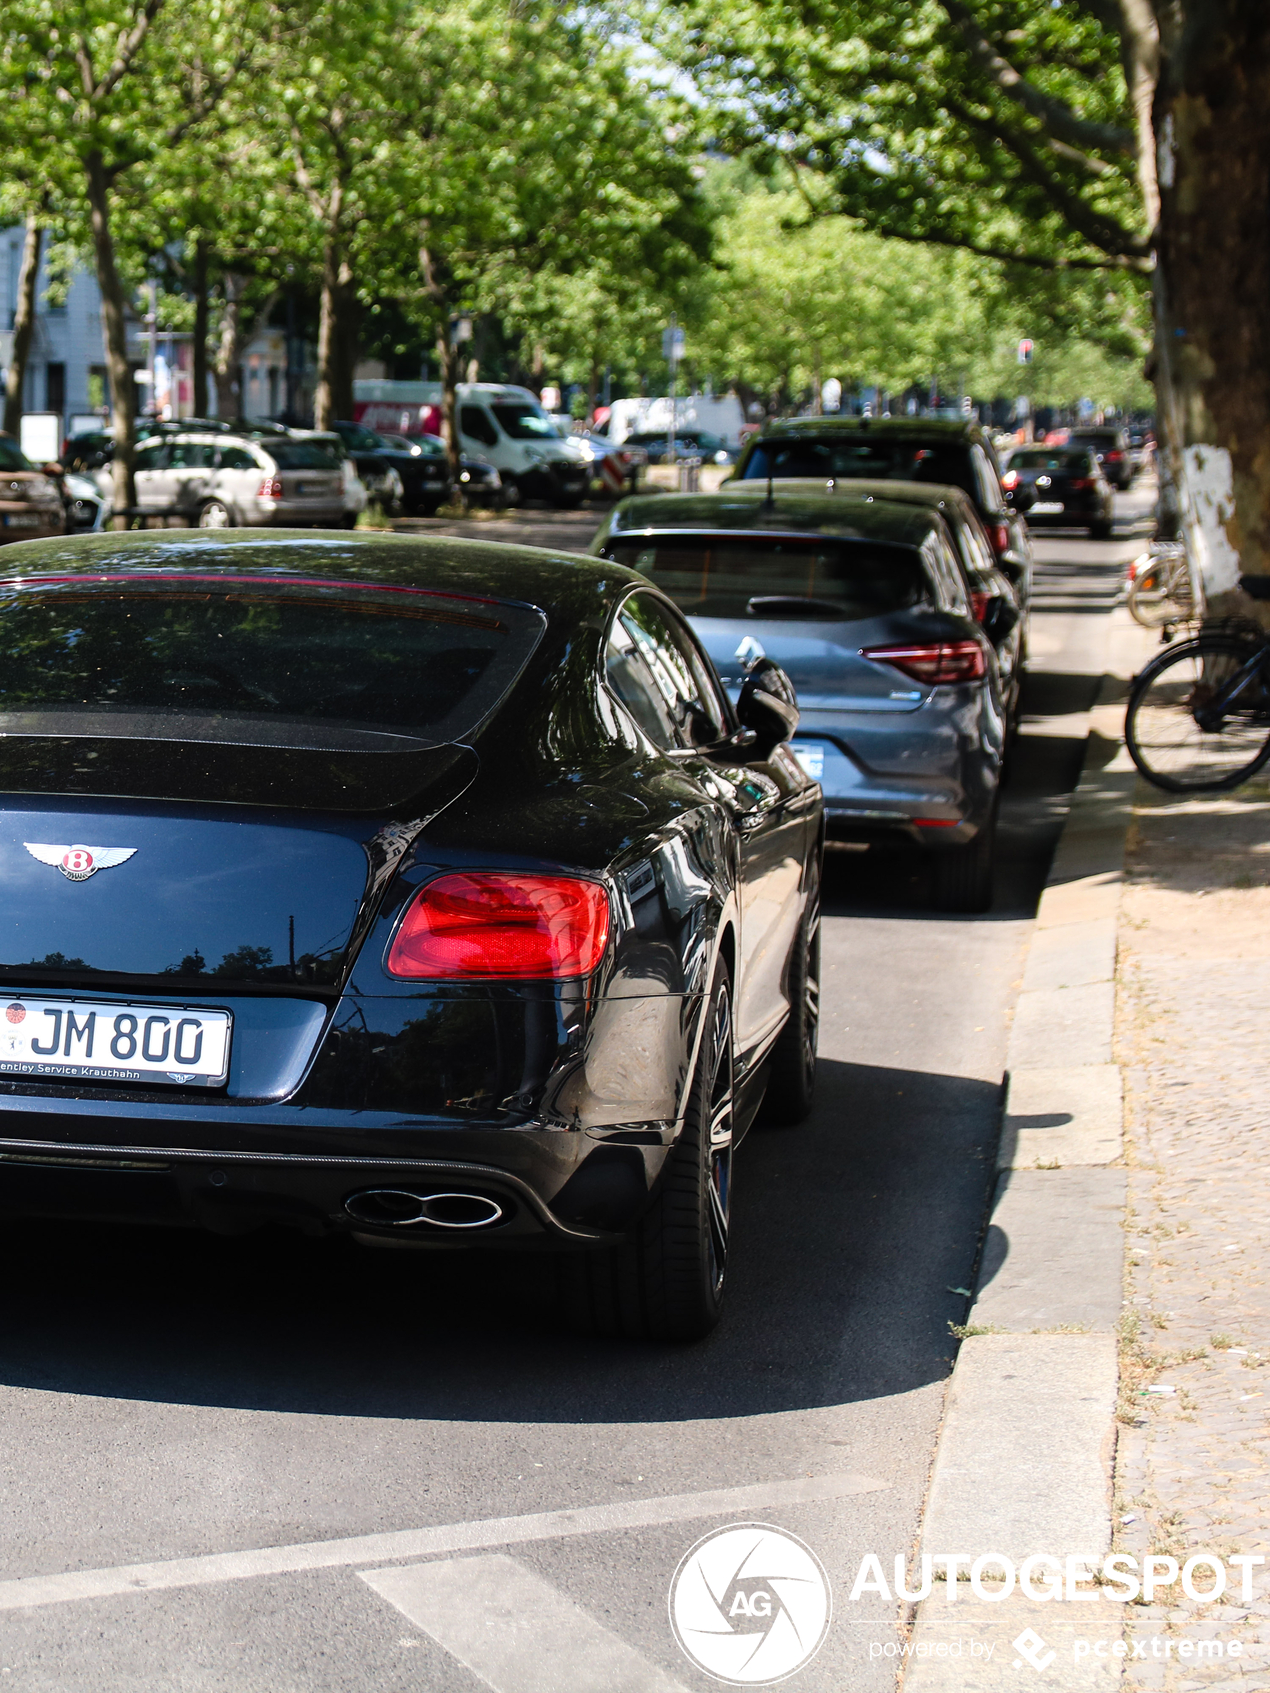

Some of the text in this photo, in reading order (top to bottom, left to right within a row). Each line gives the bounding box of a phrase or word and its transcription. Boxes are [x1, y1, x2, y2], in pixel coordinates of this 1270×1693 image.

[66, 850, 88, 871] B
[31, 1008, 96, 1058] JM
[110, 1013, 203, 1065] 800
[37, 1063, 78, 1075] Service
[81, 1066, 141, 1079] Krauthahn
